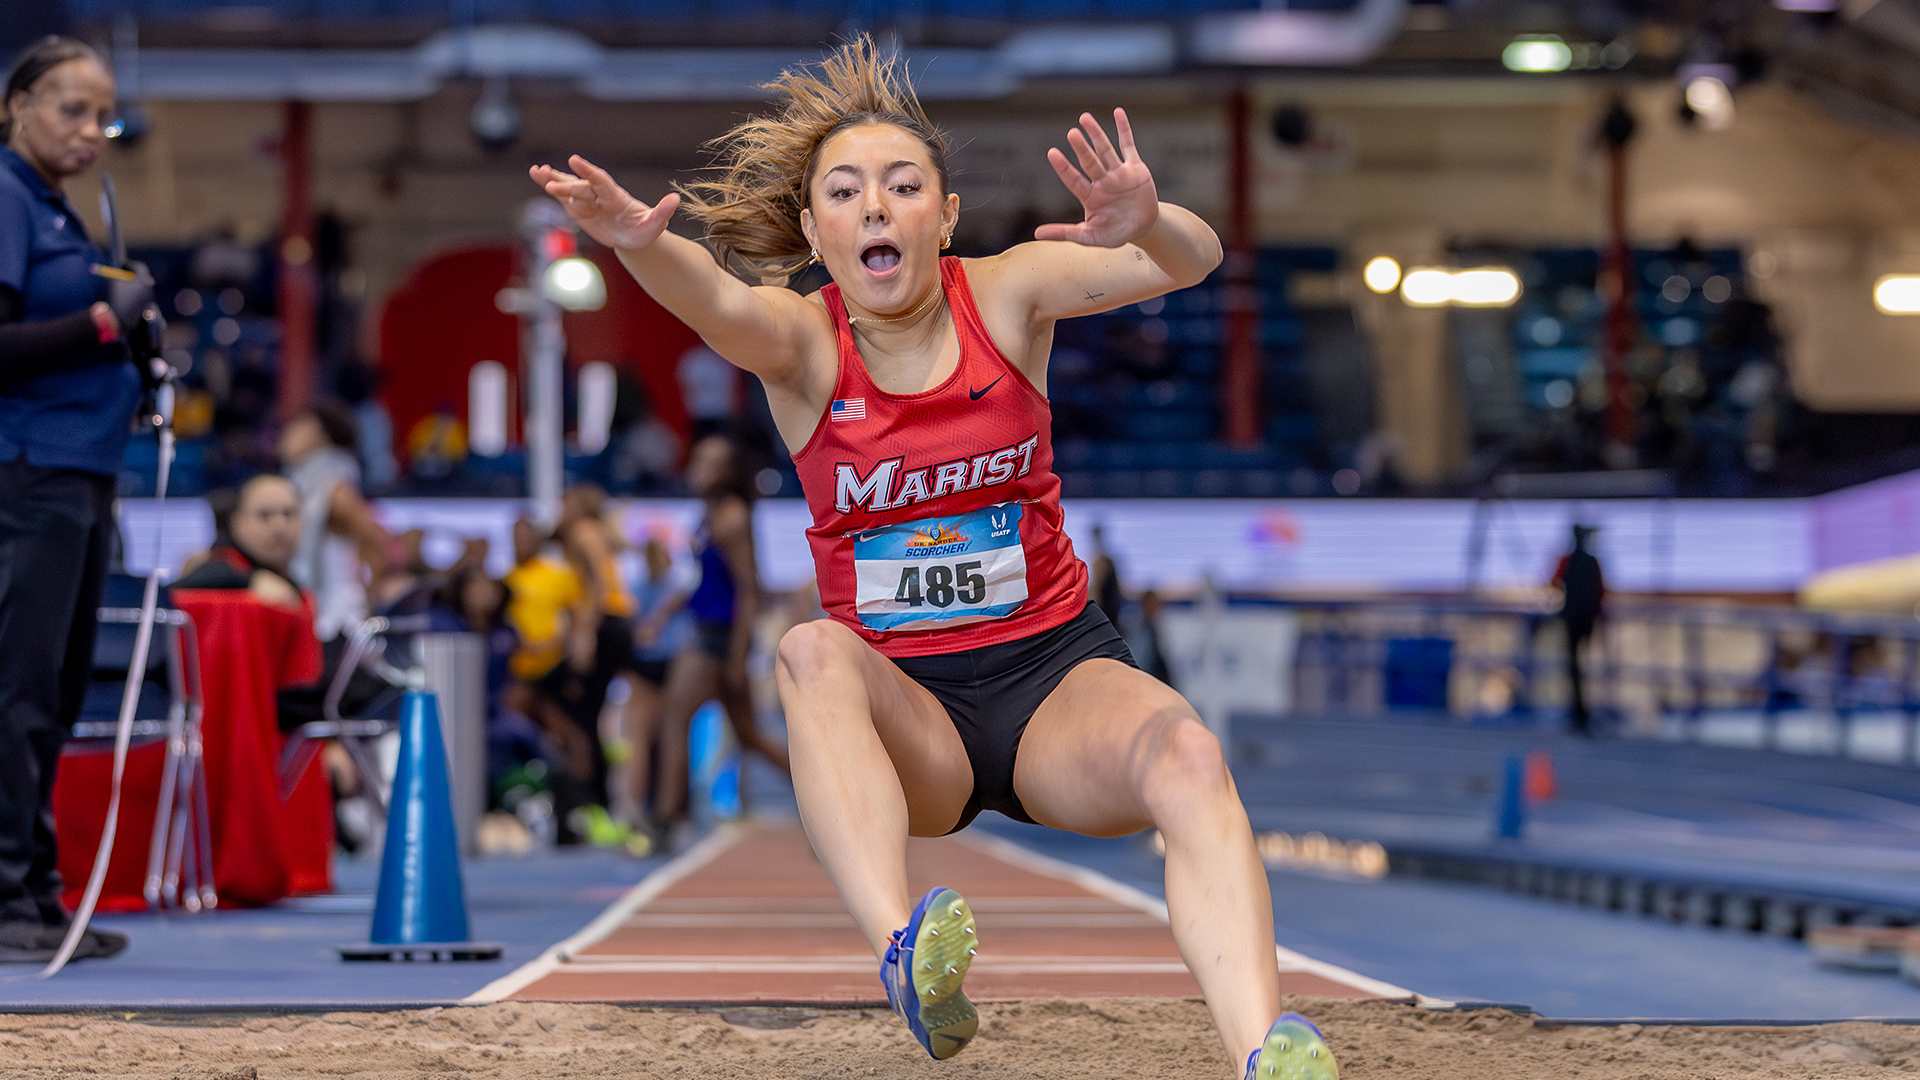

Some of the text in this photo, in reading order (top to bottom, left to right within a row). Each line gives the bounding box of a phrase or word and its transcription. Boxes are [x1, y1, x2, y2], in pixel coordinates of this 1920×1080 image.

[835, 431, 1038, 514] MARIST
[991, 529, 1011, 538] USATF
[928, 537, 958, 546] SANDER
[905, 543, 966, 557] SCORCHER
[895, 561, 986, 608] 485
